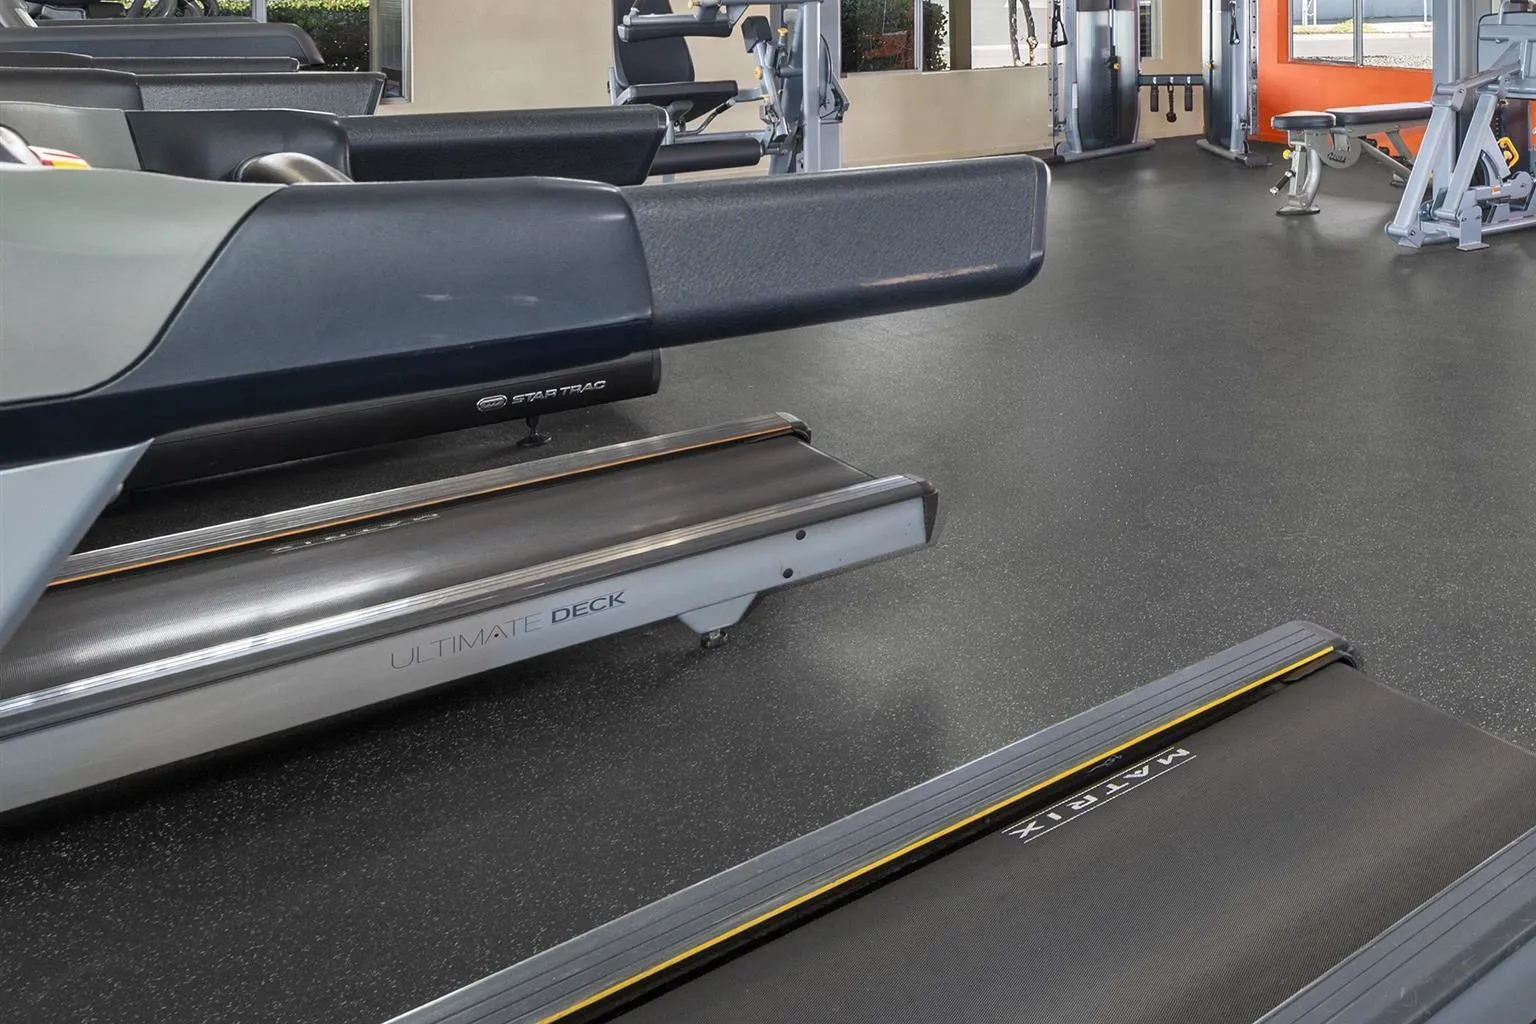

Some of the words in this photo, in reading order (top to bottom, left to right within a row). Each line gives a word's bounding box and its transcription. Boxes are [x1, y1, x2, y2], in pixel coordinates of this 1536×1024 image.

[511, 388, 558, 405] STAR
[559, 380, 607, 396] TRAC
[391, 612, 544, 670] ULTIMATE
[551, 591, 627, 623] DECK
[1008, 748, 1191, 839] MATRIX
